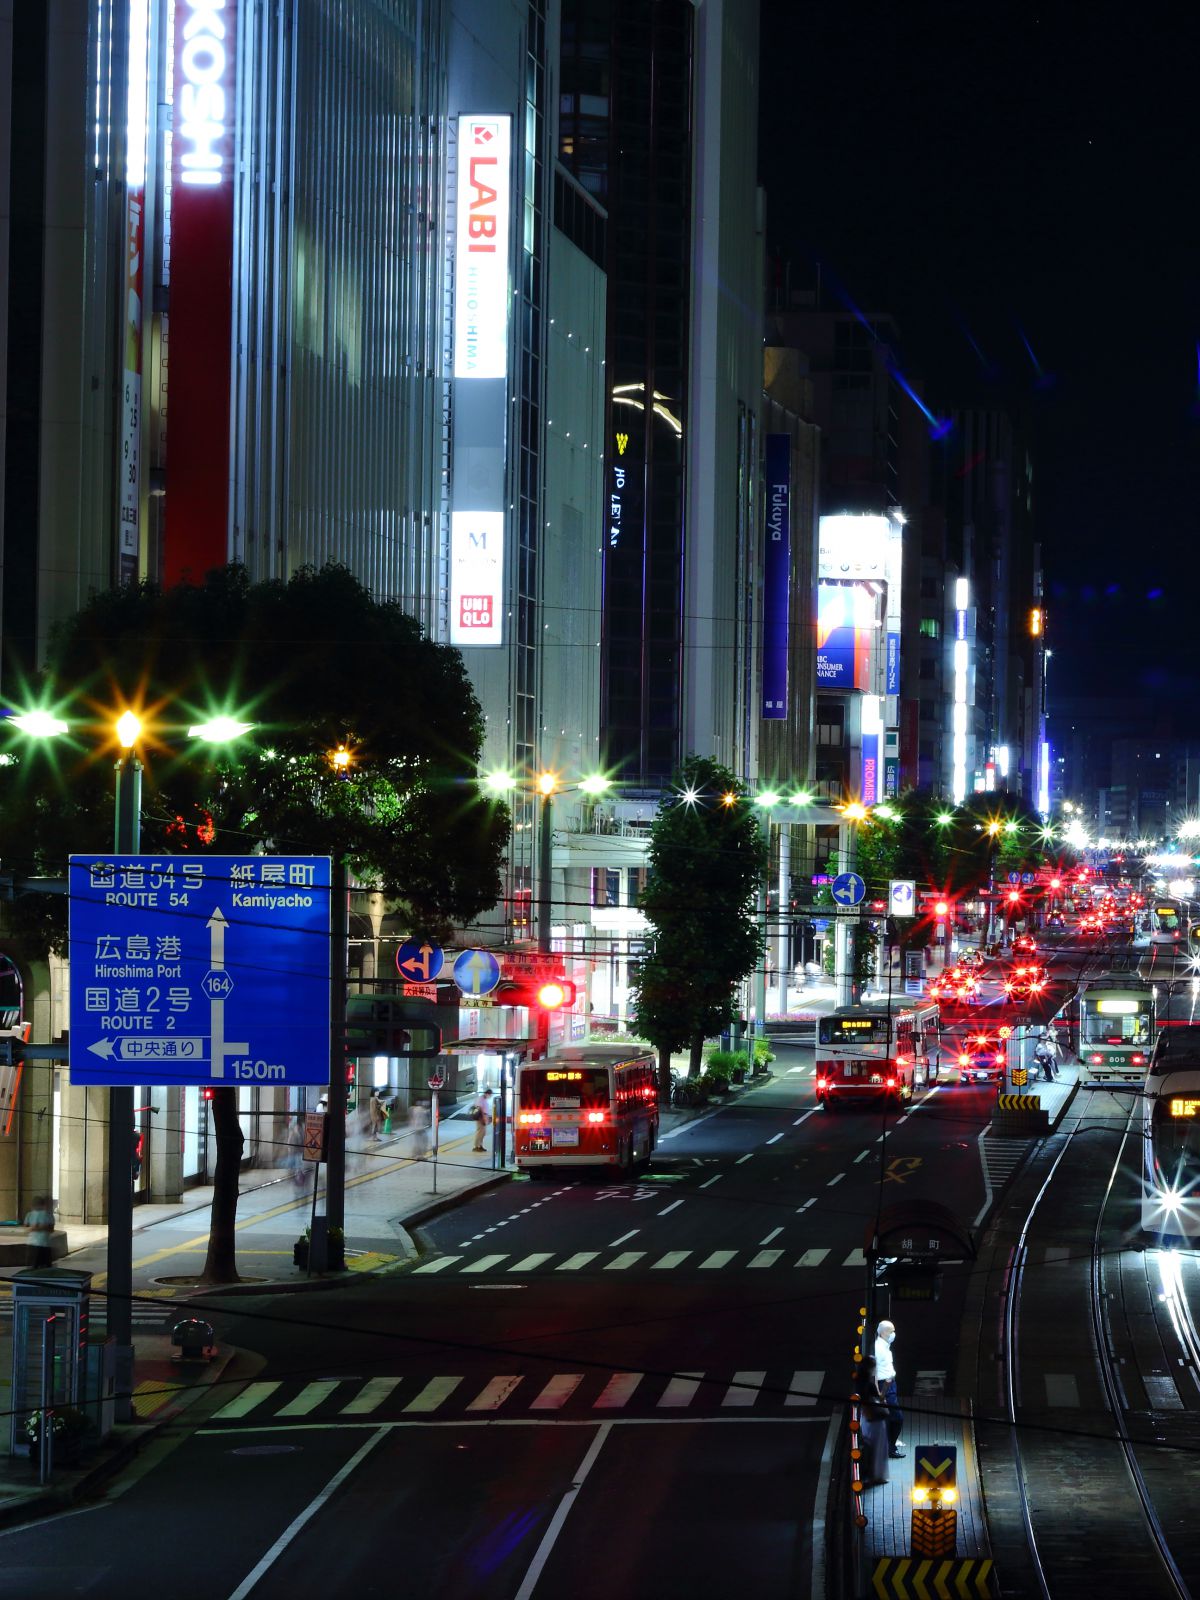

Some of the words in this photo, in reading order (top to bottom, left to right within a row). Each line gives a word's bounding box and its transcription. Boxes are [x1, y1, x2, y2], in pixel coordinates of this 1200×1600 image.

[468, 157, 497, 252] LABI
[466, 266, 479, 371] HIROSHIMA
[768, 484, 788, 540] Fukuya
[462, 598, 488, 611] UNI
[462, 612, 490, 626] QLO
[864, 759, 875, 801] PROMISE
[90, 863, 206, 889] 国道54号
[230, 864, 315, 889] 紙屋町
[105, 892, 158, 906] ROUTE
[169, 893, 189, 907] 54
[232, 893, 313, 909] Kamiyacho
[95, 934, 182, 961] 広島港
[95, 964, 153, 978] Hiroshima
[157, 965, 181, 978] Port
[207, 978, 230, 993] 164
[86, 986, 192, 1012] 国道2号
[101, 1016, 153, 1029] ROUTE
[166, 1016, 176, 1029] 2
[127, 1041, 195, 1056] 中央通り
[231, 1060, 286, 1079] 150m
